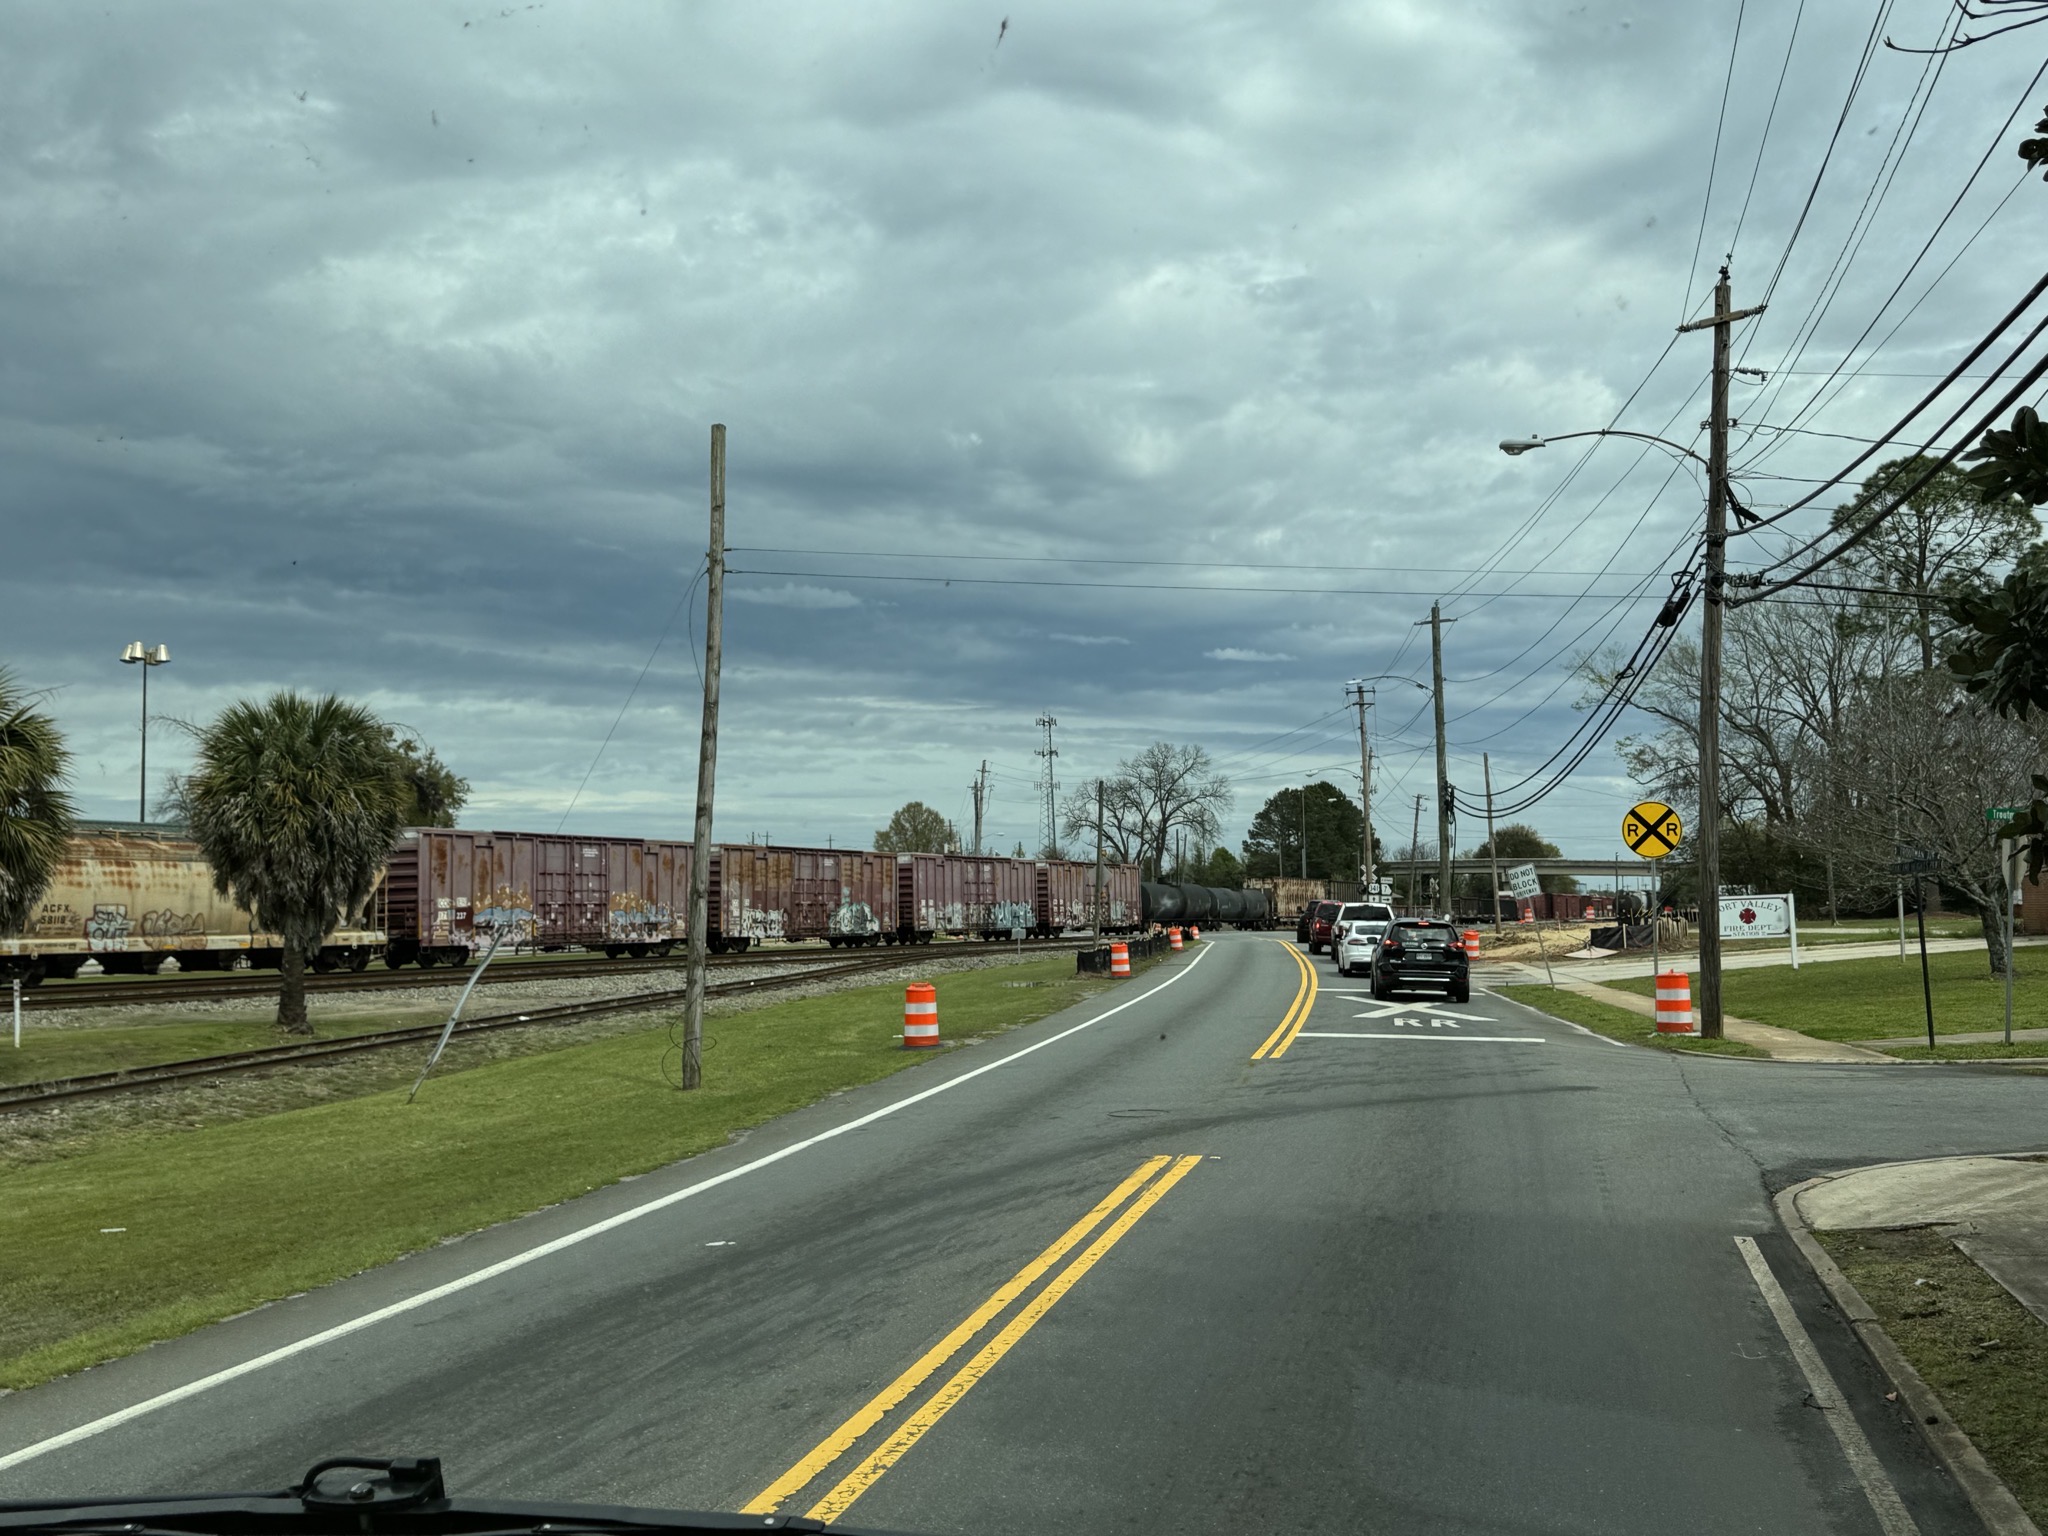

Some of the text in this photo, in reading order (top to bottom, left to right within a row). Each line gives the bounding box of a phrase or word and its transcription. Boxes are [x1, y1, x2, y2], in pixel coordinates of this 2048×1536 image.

[1627, 822, 1678, 837] R R
[1509, 867, 1534, 880] DO NOT
[1512, 878, 1538, 890] BLOCK
[42, 904, 70, 913] ACFX
[1719, 901, 1782, 912] ORT VALLEY
